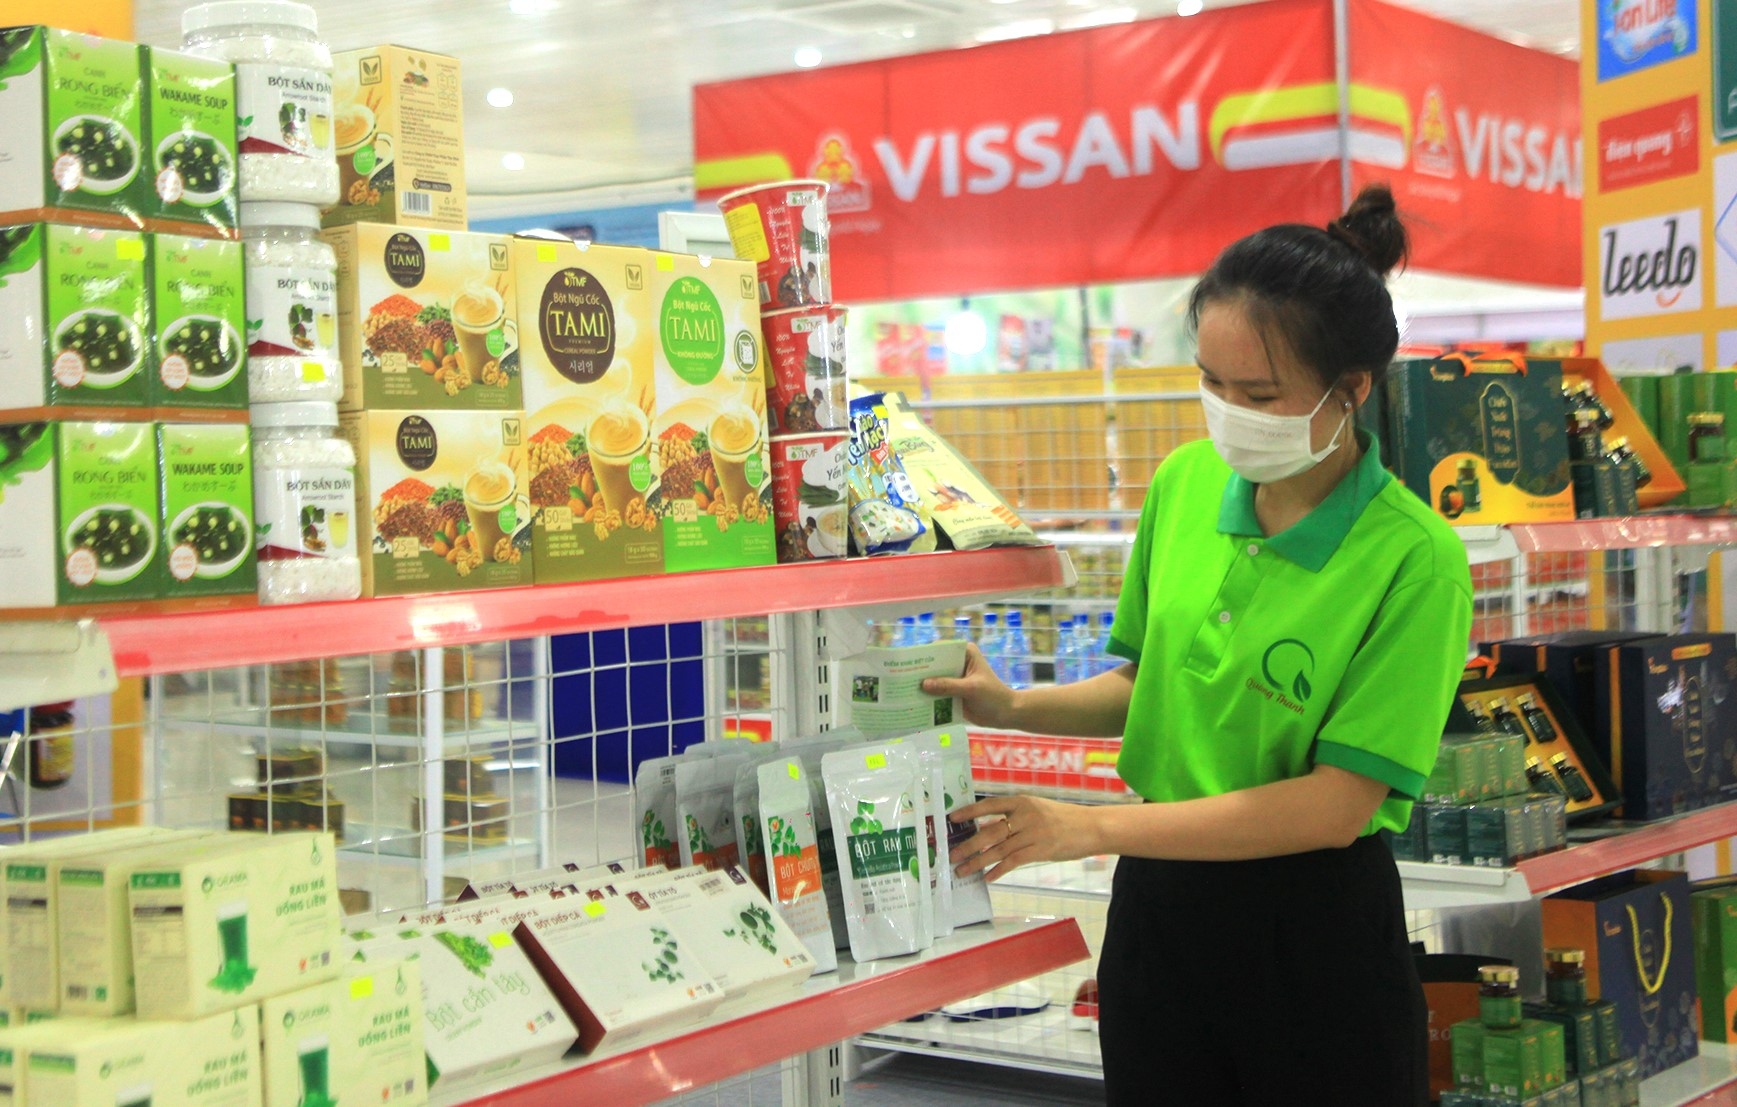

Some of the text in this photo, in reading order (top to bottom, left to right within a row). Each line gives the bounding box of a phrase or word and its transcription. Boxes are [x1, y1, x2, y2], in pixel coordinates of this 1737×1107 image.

[160, 88, 228, 110] WAKAME SOUP
[873, 98, 1202, 203] VISSAN
[390, 252, 420, 267] TAMI
[1604, 216, 1697, 298] leedo
[553, 293, 600, 306] Bột Ngũ Cốc
[672, 299, 712, 313] Bột Ngũ Cốc
[549, 310, 606, 338] TAMI
[669, 316, 716, 342] TAMI
[383, 353, 395, 367] 25
[401, 436, 432, 449] TAMI
[73, 470, 114, 485] RONG
[172, 463, 244, 476] WAKAME SOUP
[546, 509, 559, 525] 50
[674, 502, 687, 516] 50
[394, 538, 407, 552] 25
[1276, 692, 1304, 715] Thanh
[984, 744, 1083, 772] VISSAN
[855, 840, 876, 860] BỘT
[883, 836, 903, 854] RAU
[289, 875, 325, 897] RAU MÁ
[534, 919, 551, 930] BỘT
[373, 1005, 409, 1028] RAU MÁ
[426, 1002, 462, 1033] Bột
